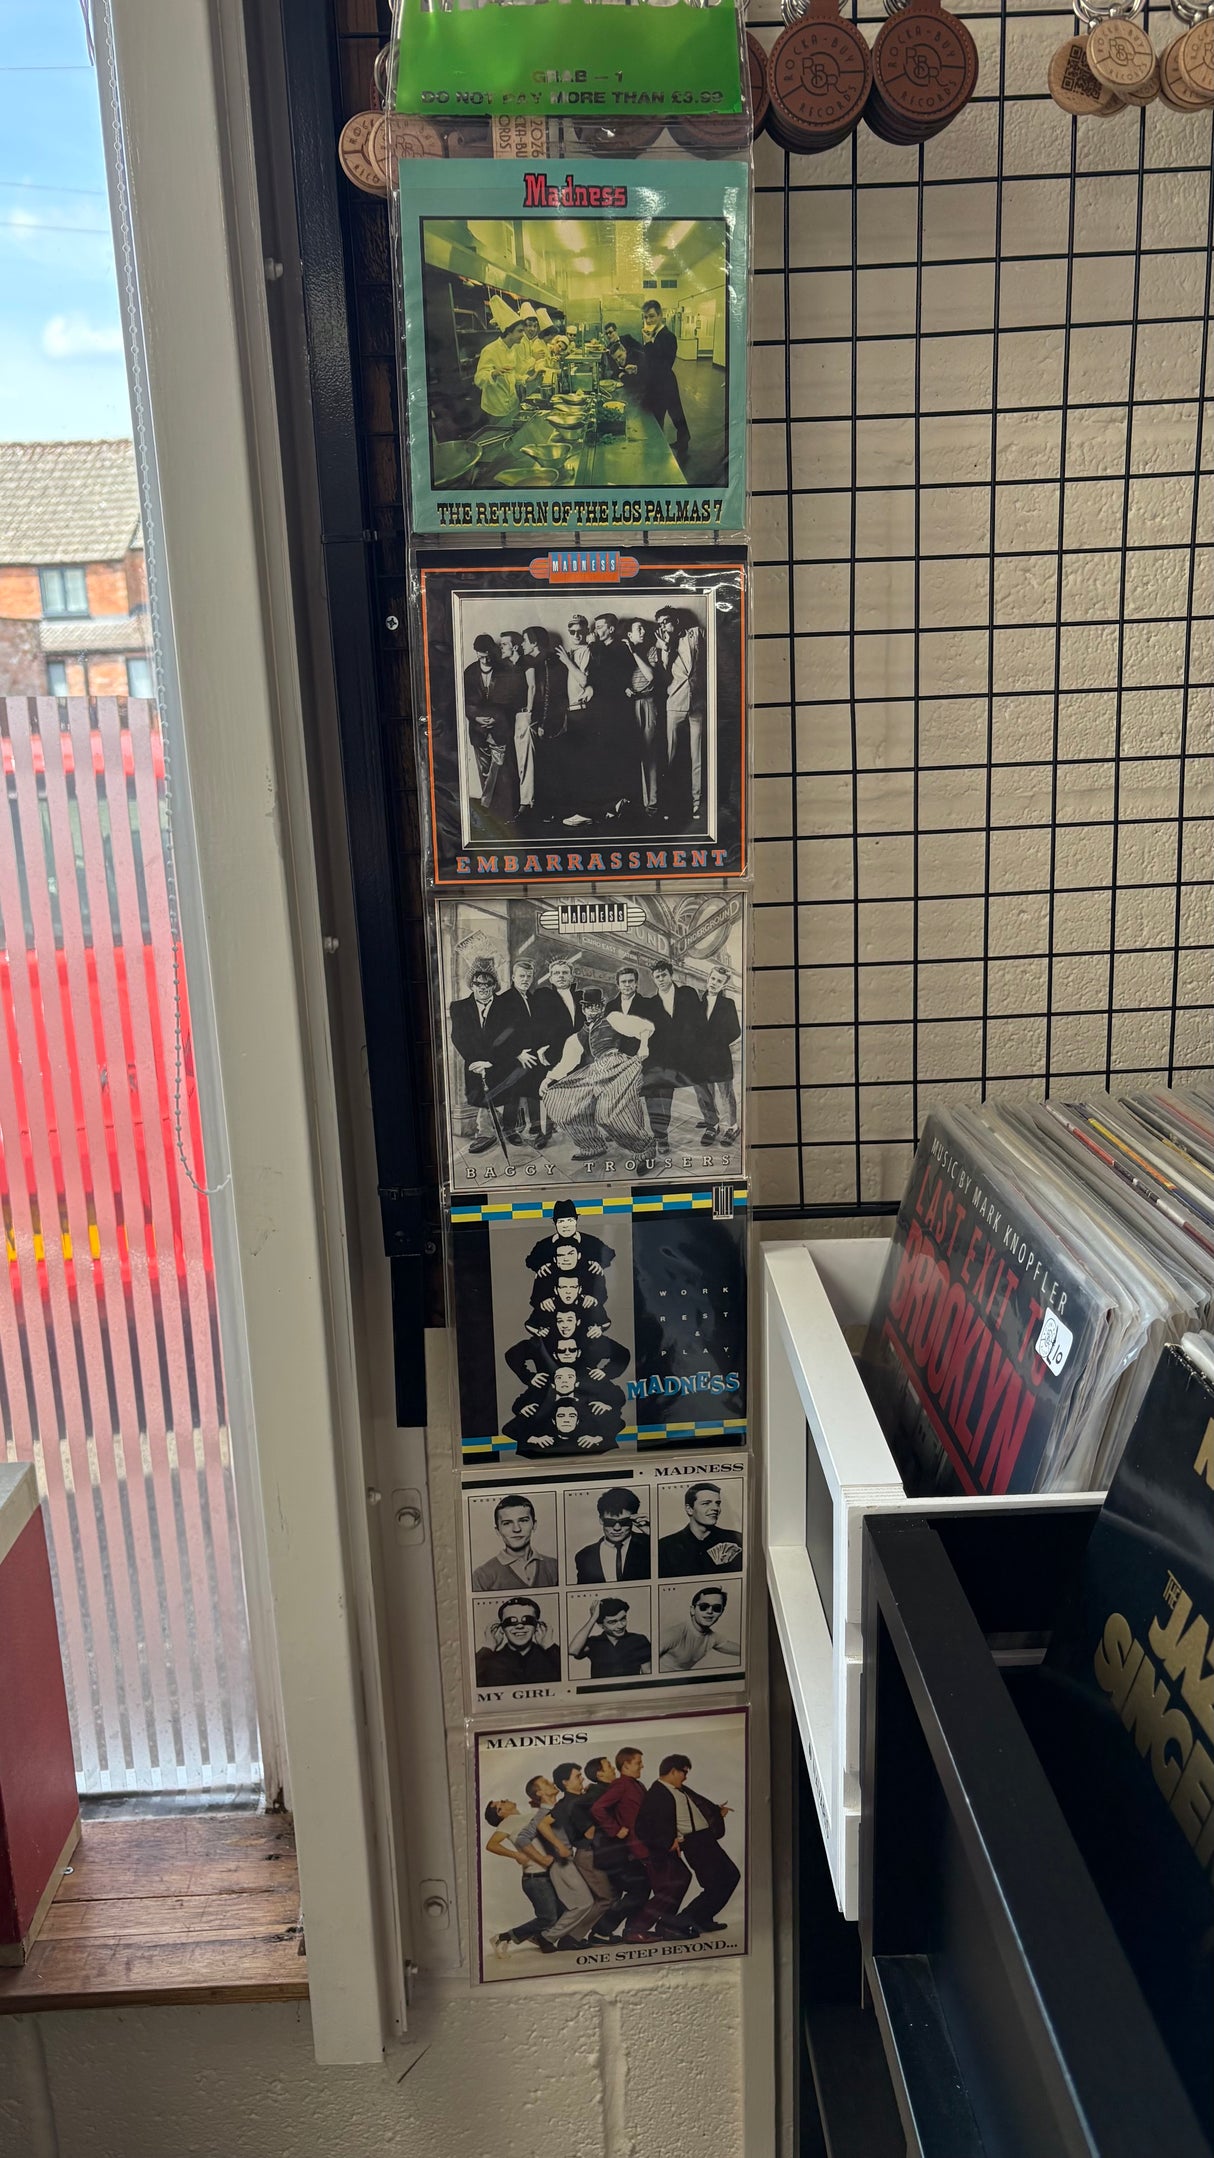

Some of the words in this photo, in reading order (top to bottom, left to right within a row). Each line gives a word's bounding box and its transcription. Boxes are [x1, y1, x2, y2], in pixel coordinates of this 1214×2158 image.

[784, 34, 854, 81] ROCKA-BUY
[888, 26, 956, 68] ROCKA-BUY
[420, 91, 449, 103] DO
[456, 92, 493, 105] NOT
[551, 91, 605, 104] MORE
[612, 91, 664, 104] THAN
[800, 86, 857, 117] RECORDS
[902, 80, 957, 108] RECORDS
[523, 173, 628, 208] Madness
[437, 503, 473, 527] THE
[476, 501, 549, 527] RETURN
[552, 501, 573, 526] OF
[574, 500, 609, 526] THE
[612, 500, 642, 526] LOS
[645, 499, 711, 526] PALMAS
[714, 500, 723, 524] 7
[552, 559, 616, 572] MADNESS
[456, 849, 727, 874] EMBARRASSMENT
[562, 910, 624, 923] MADNESS
[677, 901, 740, 953] UNDERGROUND
[466, 1164, 556, 1179] BAGGY
[584, 1154, 731, 1174] TROUSERS
[930, 1138, 958, 1180] MUSIC
[957, 1170, 973, 1195] BY
[972, 1186, 1002, 1233] MARK
[1002, 1224, 1069, 1317] KNOPFLER
[915, 1166, 967, 1257] LAST
[960, 1234, 1020, 1330] EXIT
[659, 1287, 729, 1298] WORK
[660, 1311, 728, 1322] REST
[661, 1346, 729, 1357] PLAY
[889, 1219, 1038, 1496] BROOKLYN
[627, 1371, 740, 1401] MADNESS
[654, 1462, 744, 1478] MADNESS
[1162, 1569, 1182, 1610] THE
[477, 1690, 504, 1702] MY
[512, 1688, 556, 1700] GIRL
[486, 1732, 589, 1749] MADNESS
[576, 1952, 610, 1966] ONE
[615, 1948, 658, 1962] STEP
